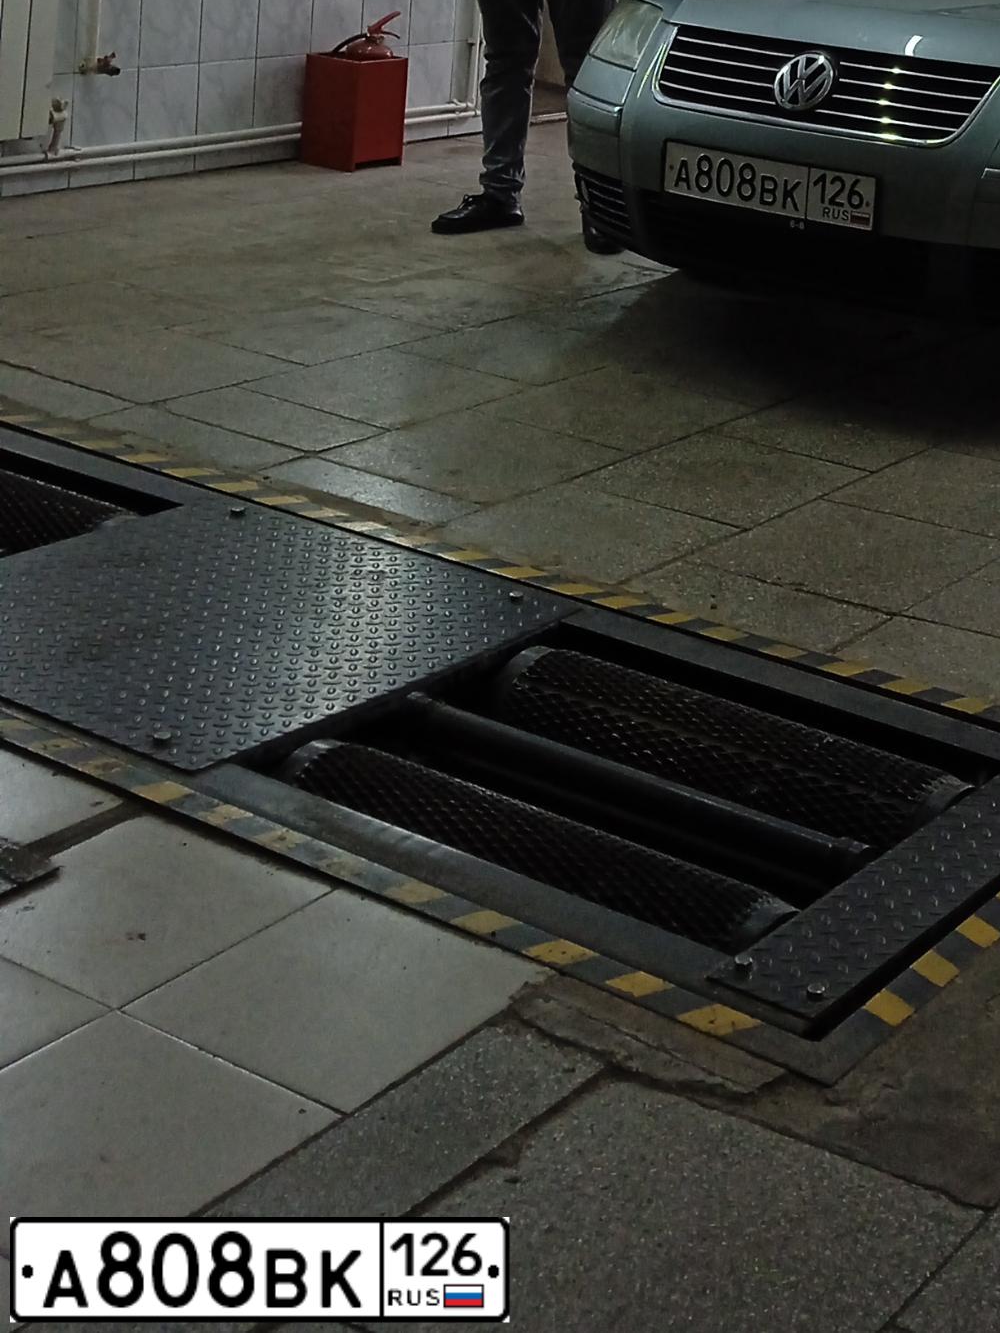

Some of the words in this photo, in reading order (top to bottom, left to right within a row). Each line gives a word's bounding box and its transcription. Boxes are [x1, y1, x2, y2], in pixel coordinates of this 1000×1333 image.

[674, 153, 802, 212] А808ВК
[813, 173, 864, 210] 126
[822, 207, 849, 221] RUS
